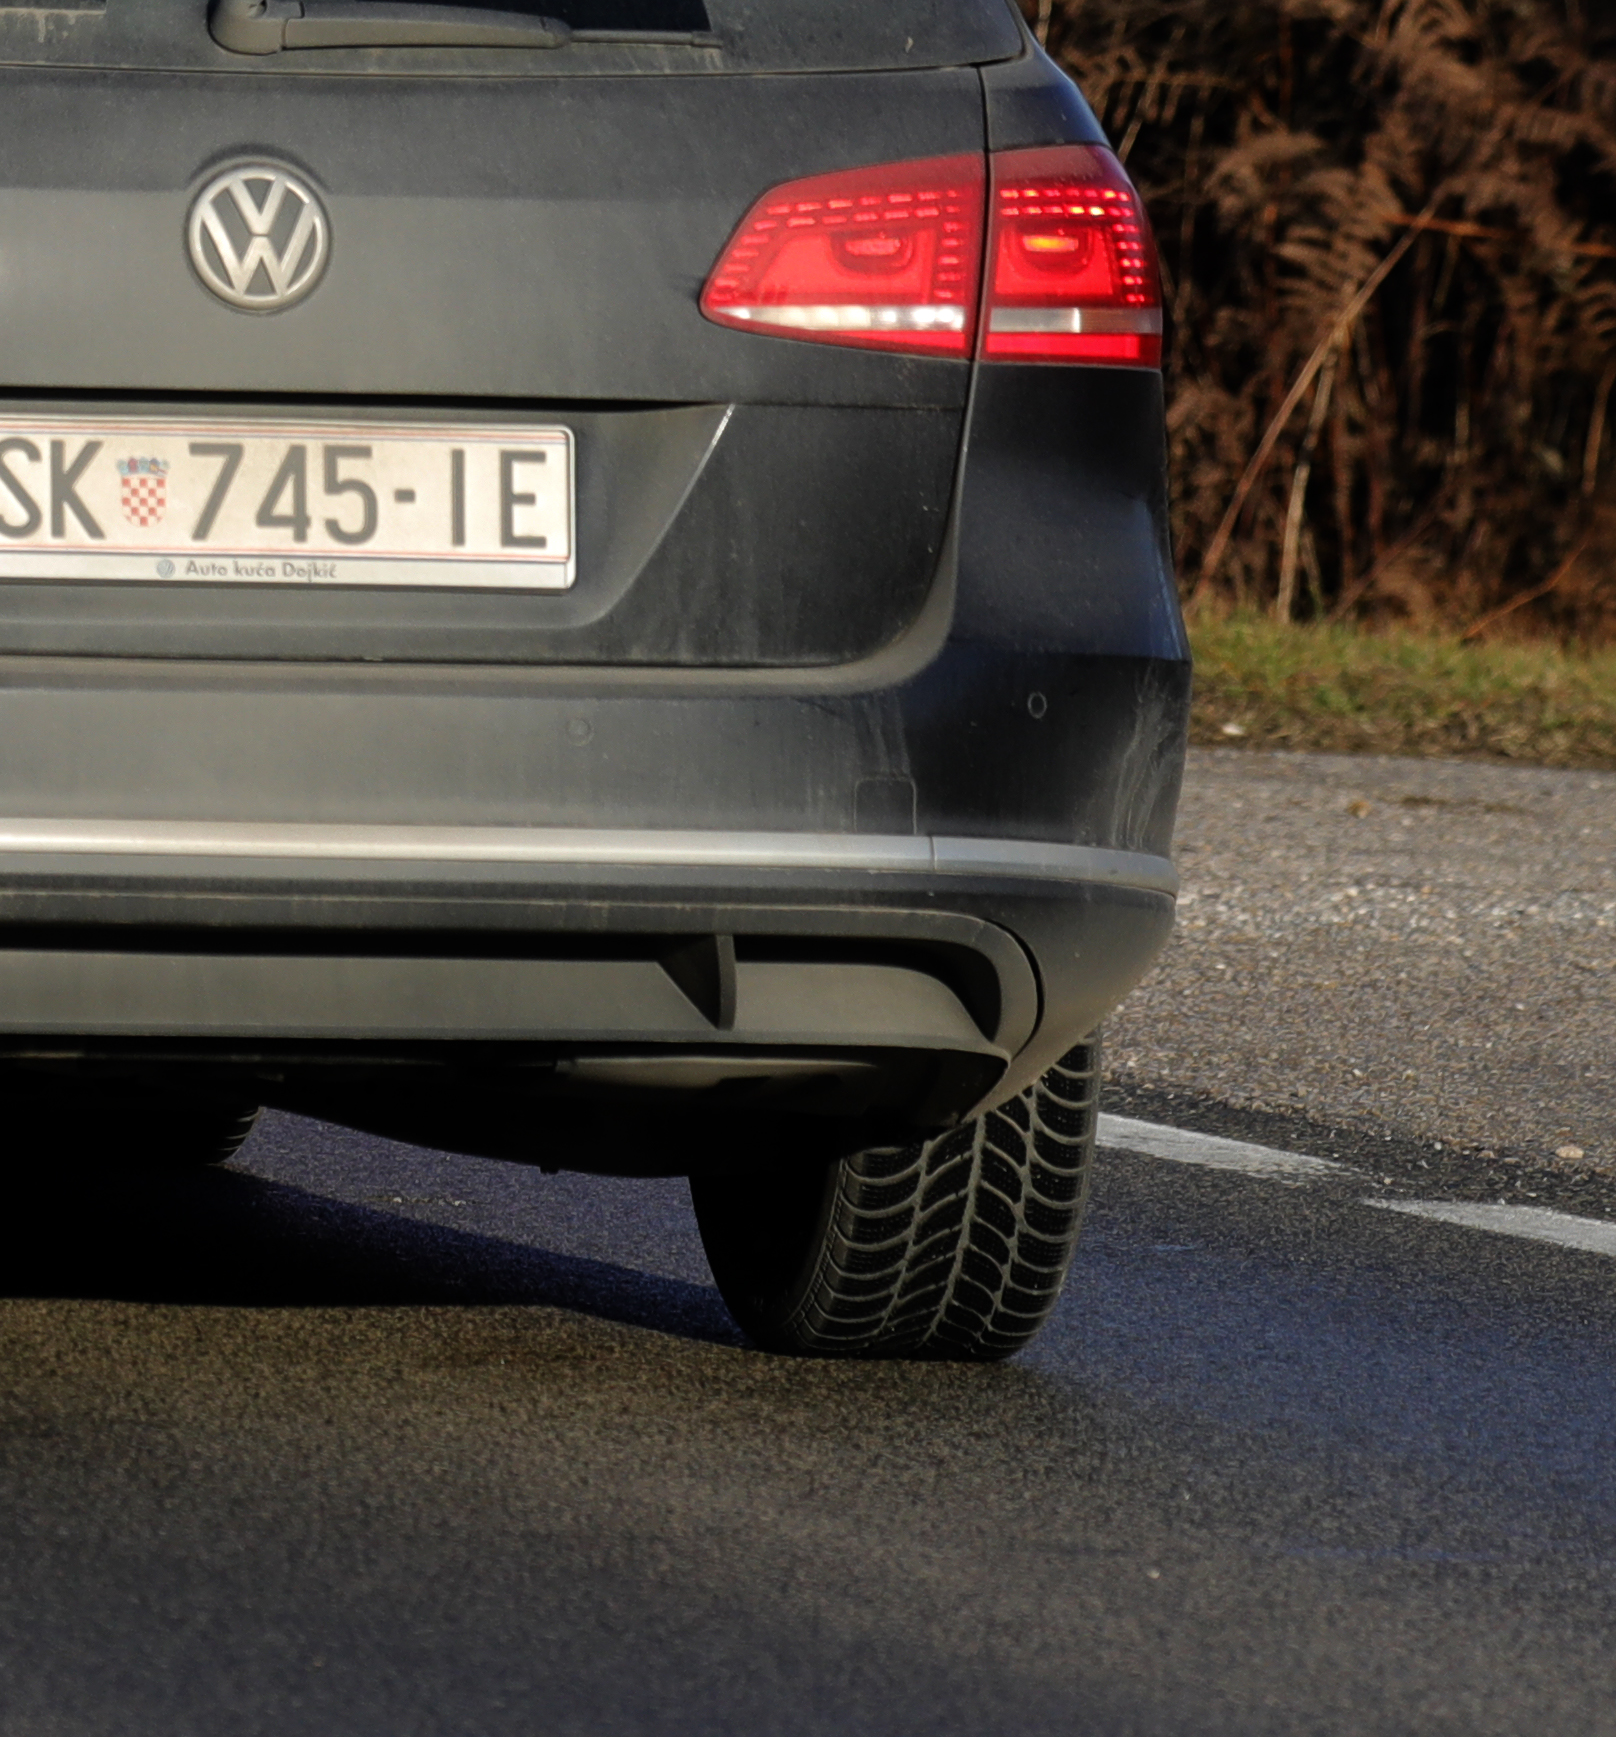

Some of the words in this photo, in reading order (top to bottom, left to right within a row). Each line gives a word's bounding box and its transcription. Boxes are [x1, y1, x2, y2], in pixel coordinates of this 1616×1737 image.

[188, 441, 548, 549] 745-IE
[185, 559, 229, 577] Auto
[234, 558, 277, 578] kuća
